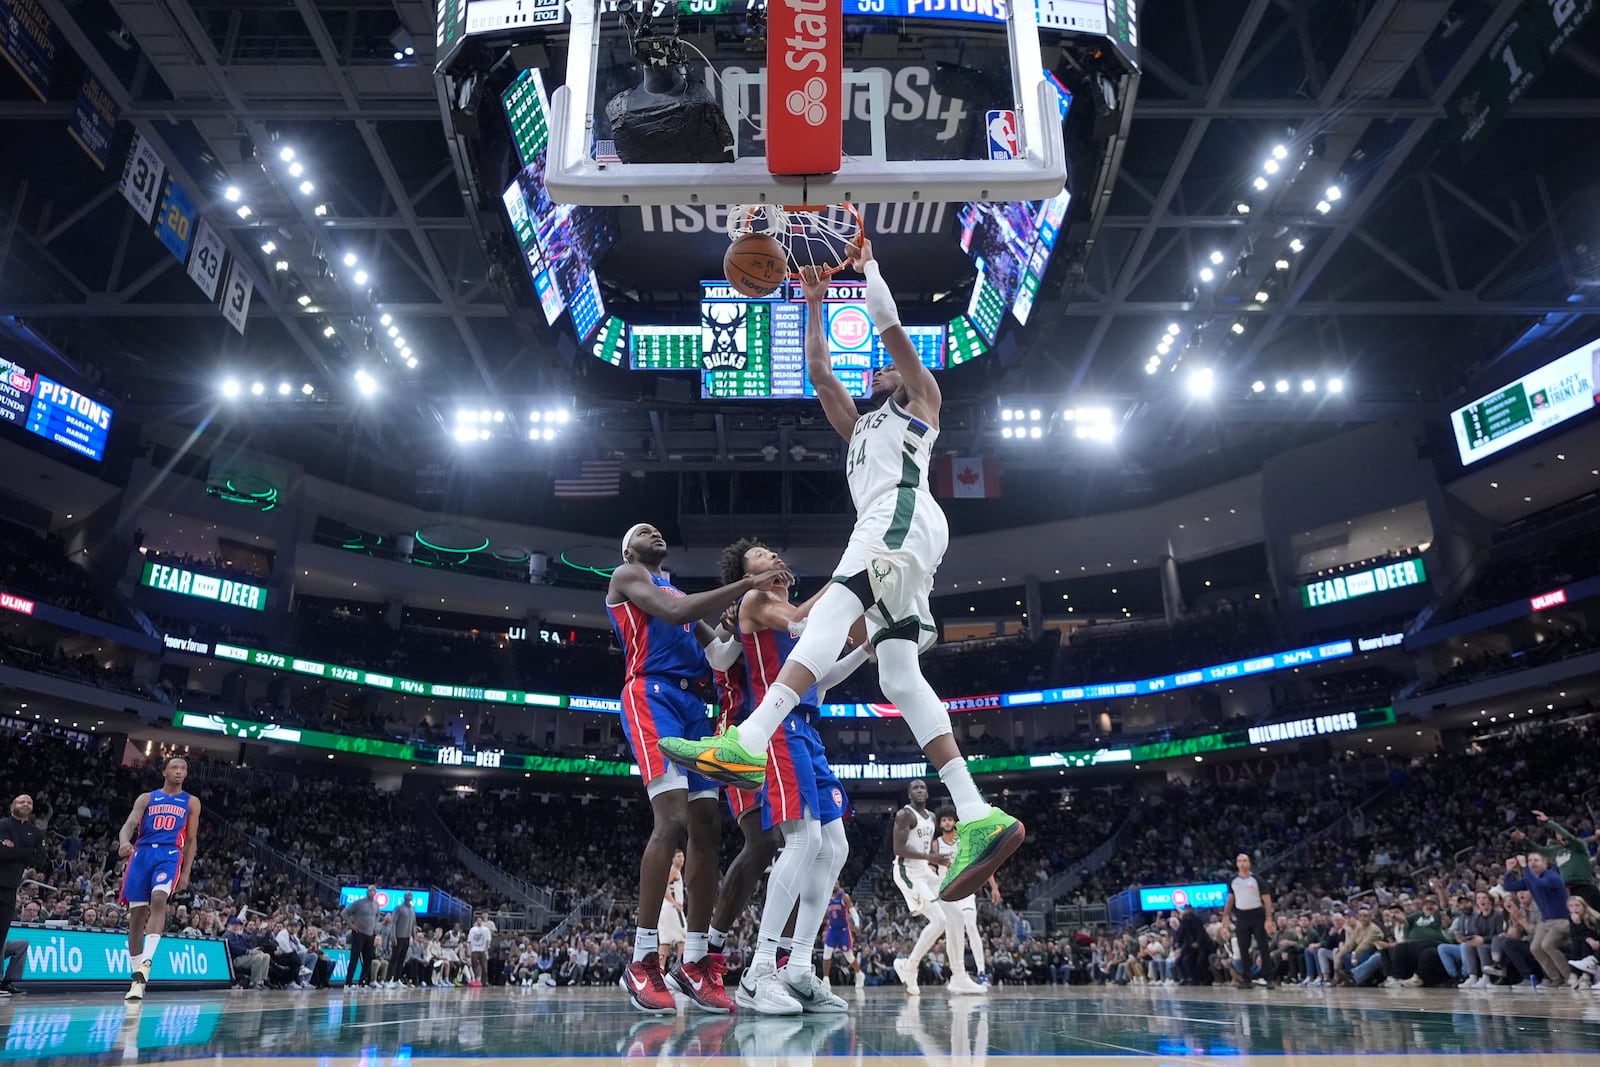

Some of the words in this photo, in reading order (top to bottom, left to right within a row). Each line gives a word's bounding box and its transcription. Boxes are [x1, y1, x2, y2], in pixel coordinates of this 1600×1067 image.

[516, 1, 521, 10] 1
[535, 11, 557, 21] TOL
[1502, 45, 1522, 85] 1
[133, 158, 157, 203] 31
[167, 204, 189, 240] 20
[199, 246, 218, 279] 43
[232, 282, 246, 313] 3
[837, 321, 864, 336] DET
[702, 352, 747, 369] BUCKS
[38, 381, 110, 430] PISTONS
[66, 415, 94, 432] BEASLEY
[66, 427, 89, 442] HARRIS
[54, 433, 96, 456] CUNNINGHAM
[149, 563, 192, 594] FEAR
[220, 579, 260, 609] DEER
[1307, 578, 1348, 607] FEAR
[1374, 560, 1419, 592] DEER
[1, 595, 32, 612] ULINE
[1532, 590, 1565, 609] ULINE
[255, 653, 286, 667] 33/72
[331, 667, 359, 681] 12/28
[830, 705, 845, 716] 93
[1248, 718, 1316, 744] MILWAUKEE
[1315, 712, 1358, 734] BUCKS
[437, 748, 462, 765] FEAR
[476, 750, 500, 767] DEER
[864, 762, 889, 778] MADE
[891, 762, 927, 777] NIGHTLY
[148, 804, 186, 818] DETROIT
[154, 815, 175, 830] 00
[1195, 891, 1223, 901] CLUB
[27, 936, 83, 974] wilo
[169, 944, 208, 975] wilo
